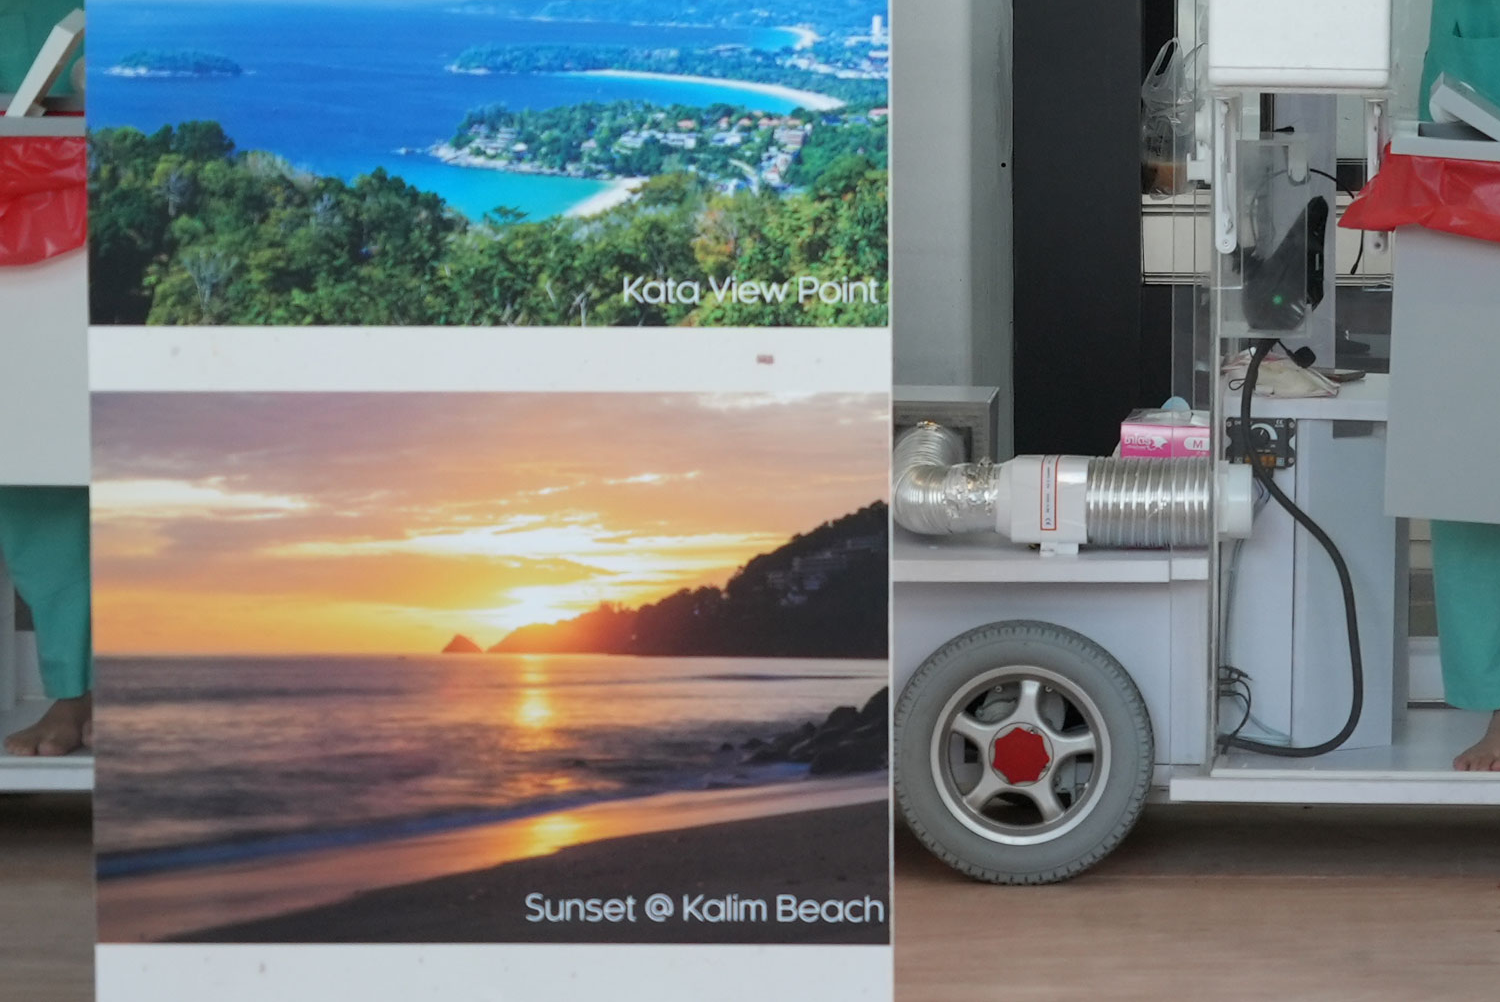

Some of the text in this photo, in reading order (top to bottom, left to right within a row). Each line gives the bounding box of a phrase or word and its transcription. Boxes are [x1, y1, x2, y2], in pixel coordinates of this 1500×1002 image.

[622, 276, 879, 304] Kata View Point
[1192, 439, 1203, 449] M
[524, 892, 885, 924] Sunset @ Kalim Beach
